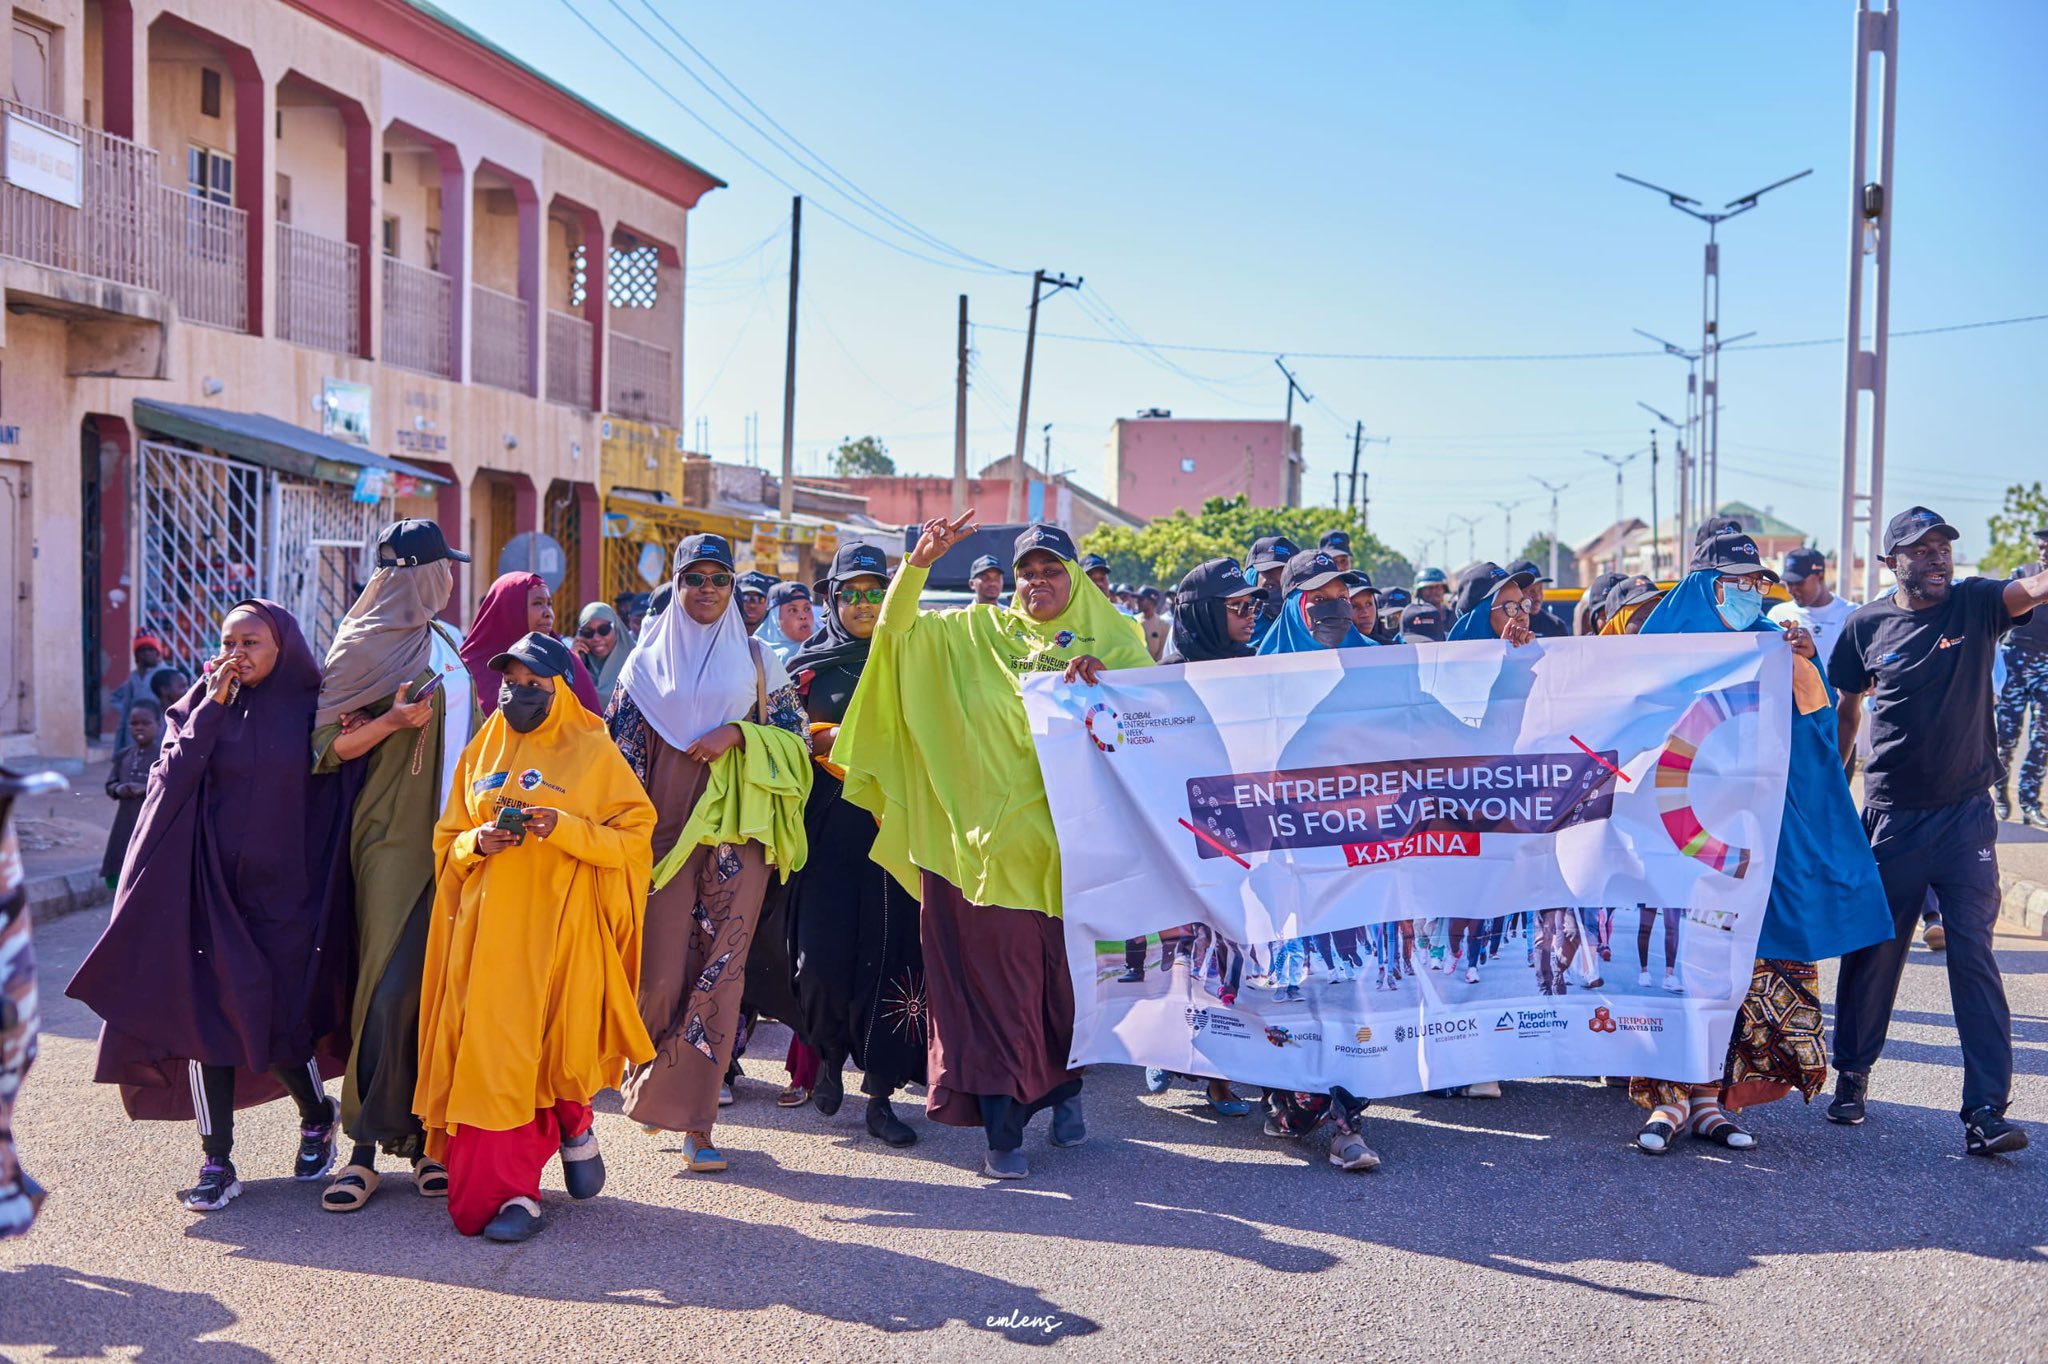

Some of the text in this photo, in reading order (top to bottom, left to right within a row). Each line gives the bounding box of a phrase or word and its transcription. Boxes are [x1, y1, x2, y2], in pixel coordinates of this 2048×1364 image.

[1123, 712, 1152, 720] GLOBAL
[1124, 716, 1196, 729] ENTREPRENEURSHIP
[1125, 729, 1144, 737] WEEK
[1126, 736, 1155, 745] NIGERIA
[1233, 764, 1573, 809] ENTREPRENEURSHIP
[1268, 796, 1554, 838] IS FOR EVERYONE
[1353, 833, 1468, 865] KATSINA
[1517, 1010, 1557, 1021] Tripoint
[1617, 1016, 1664, 1026] TRIPOINT
[1407, 1018, 1478, 1039] BLUEROCK
[1518, 1019, 1568, 1030] Academy
[1334, 1045, 1388, 1054] PROVIDUSBANK
